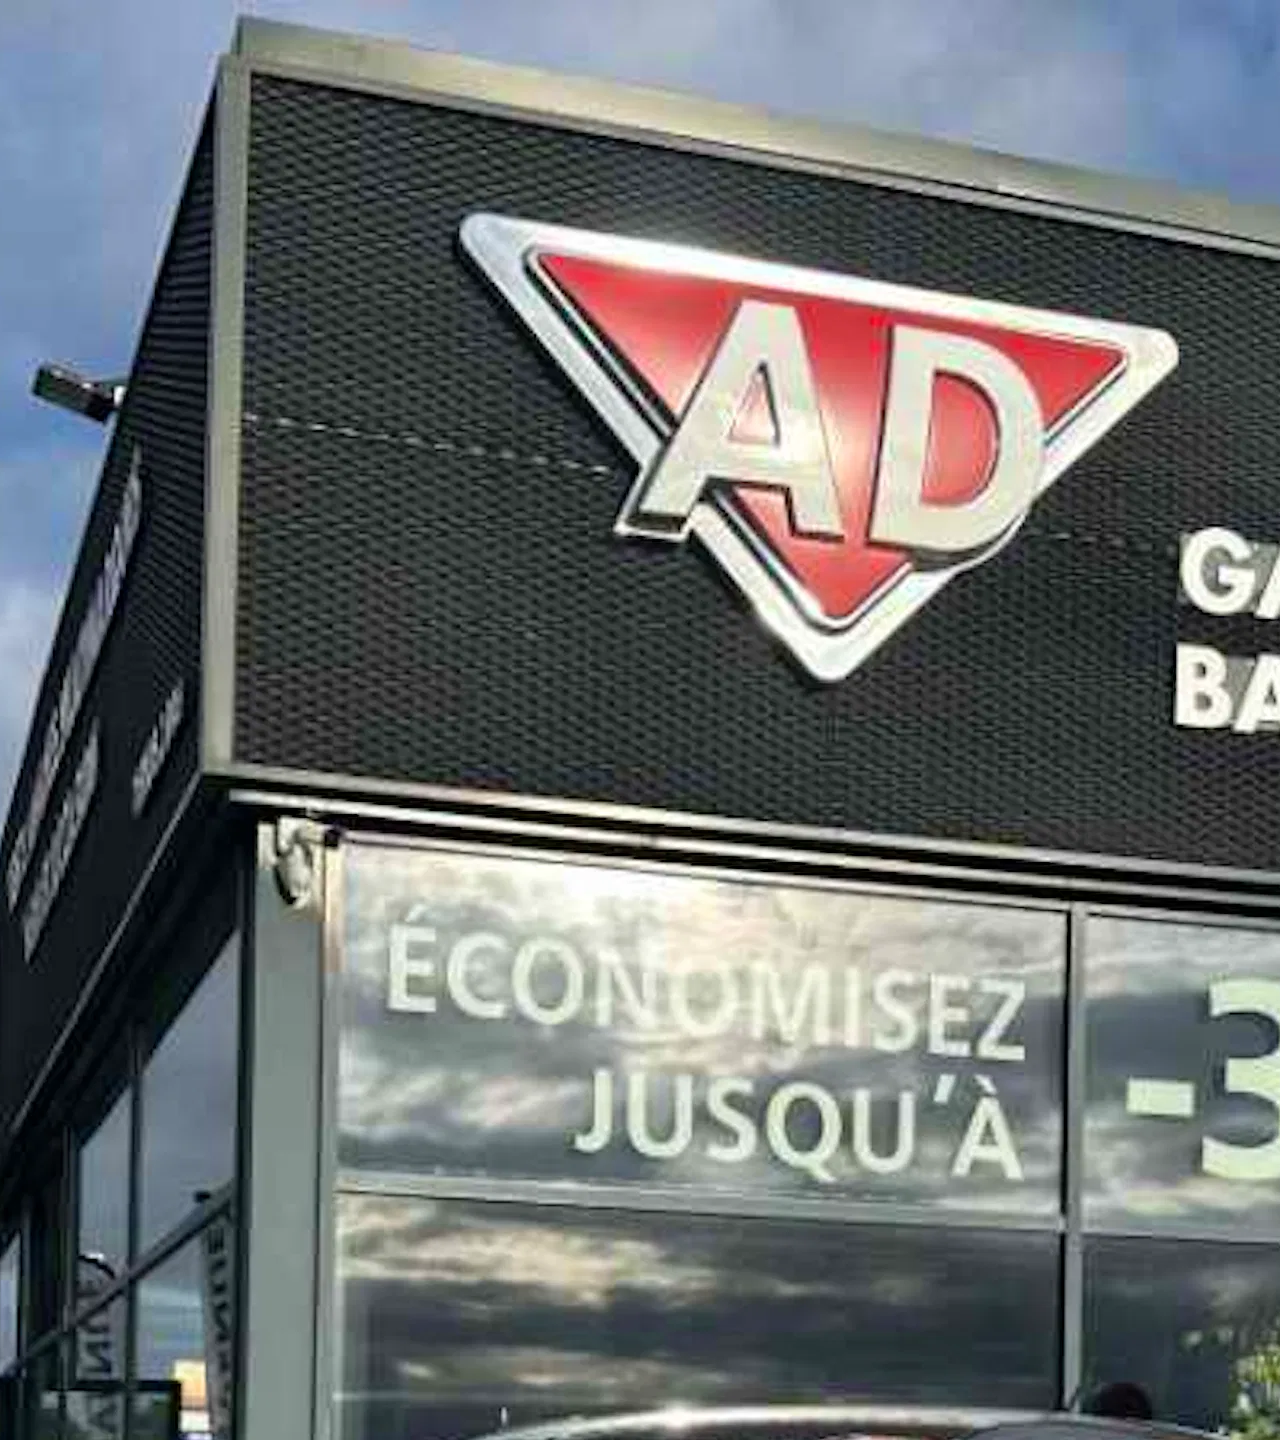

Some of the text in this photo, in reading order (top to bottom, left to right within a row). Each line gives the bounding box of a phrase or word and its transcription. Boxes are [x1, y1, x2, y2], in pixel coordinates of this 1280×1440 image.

[639, 298, 1047, 553] AD
[386, 910, 1026, 1062] ÉCONOMISEZ
[574, 1068, 1021, 1183] JUSQU'À
